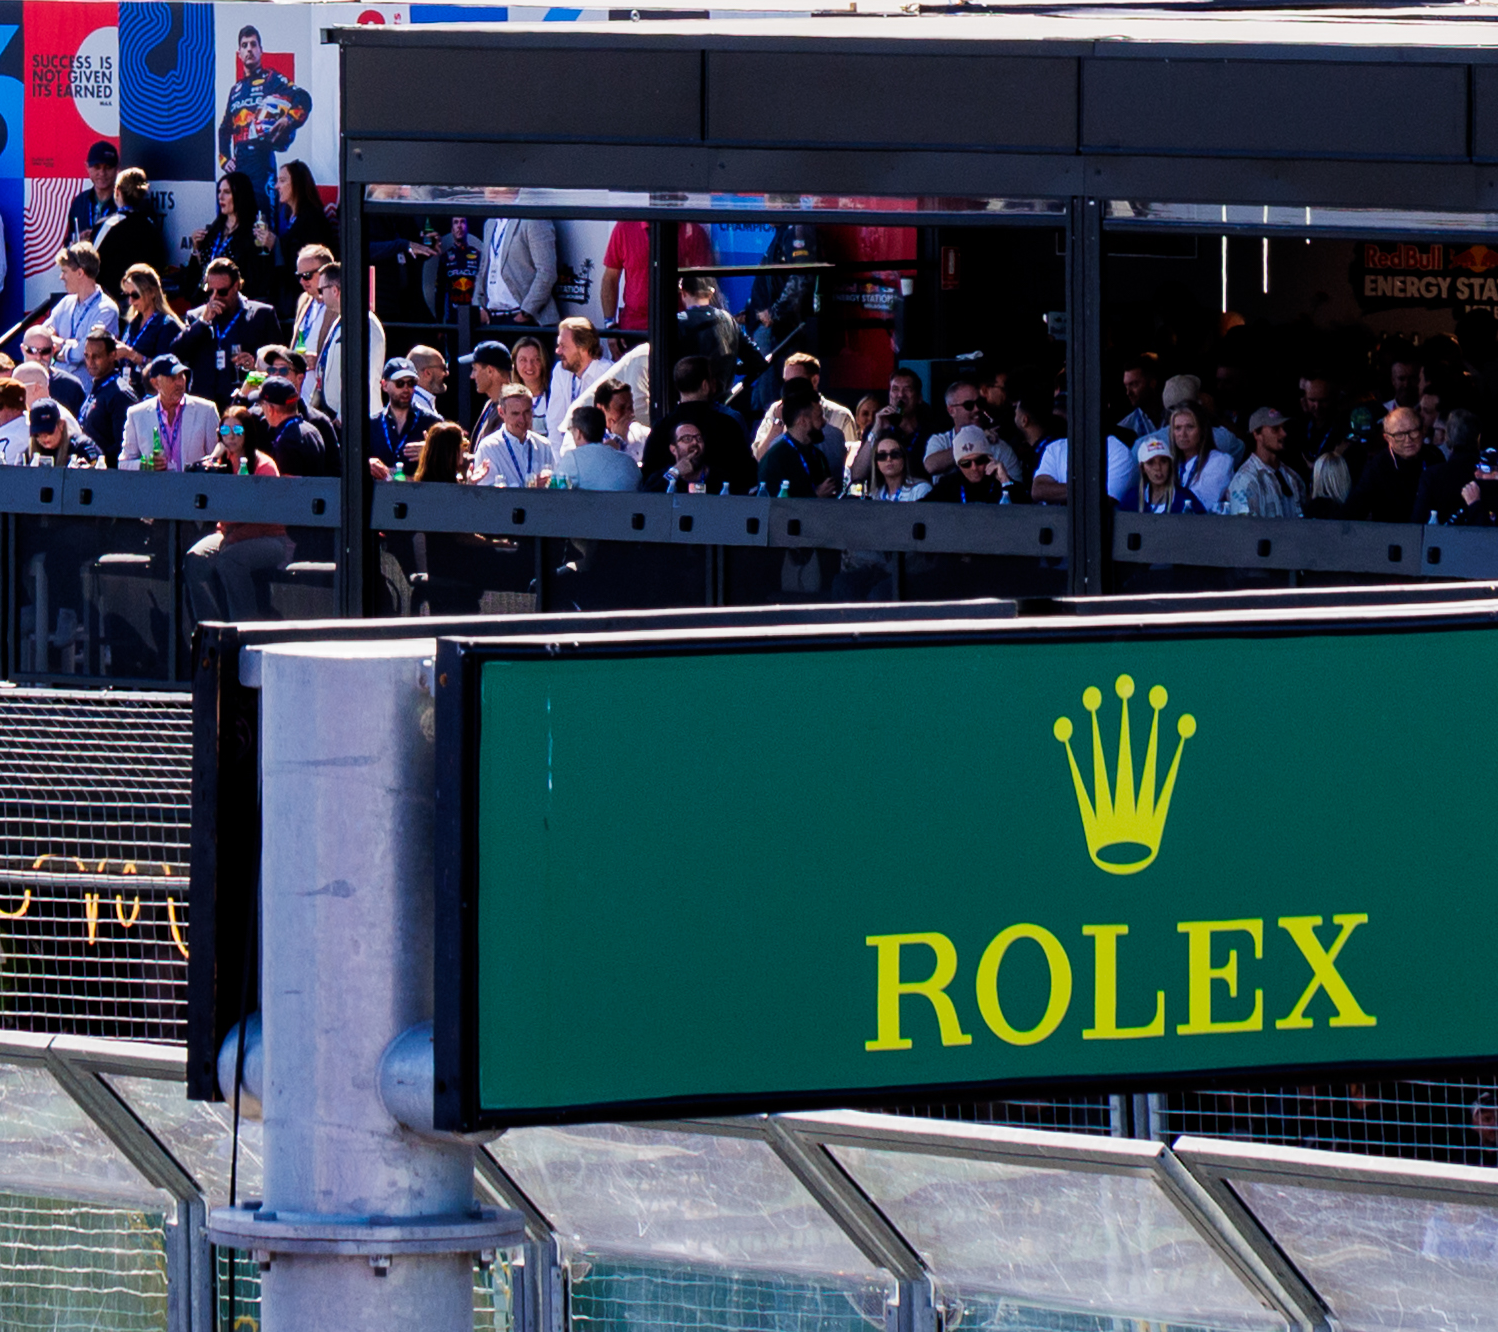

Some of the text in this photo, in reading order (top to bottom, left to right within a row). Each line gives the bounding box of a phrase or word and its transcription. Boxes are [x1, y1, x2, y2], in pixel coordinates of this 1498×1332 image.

[32, 54, 113, 70] SUCCESS IS
[32, 68, 113, 84] NOT GIVEN
[32, 83, 113, 99] ITS EARNED
[1364, 275, 1452, 299] ENERGY
[864, 913, 1377, 1052] ROLEX
